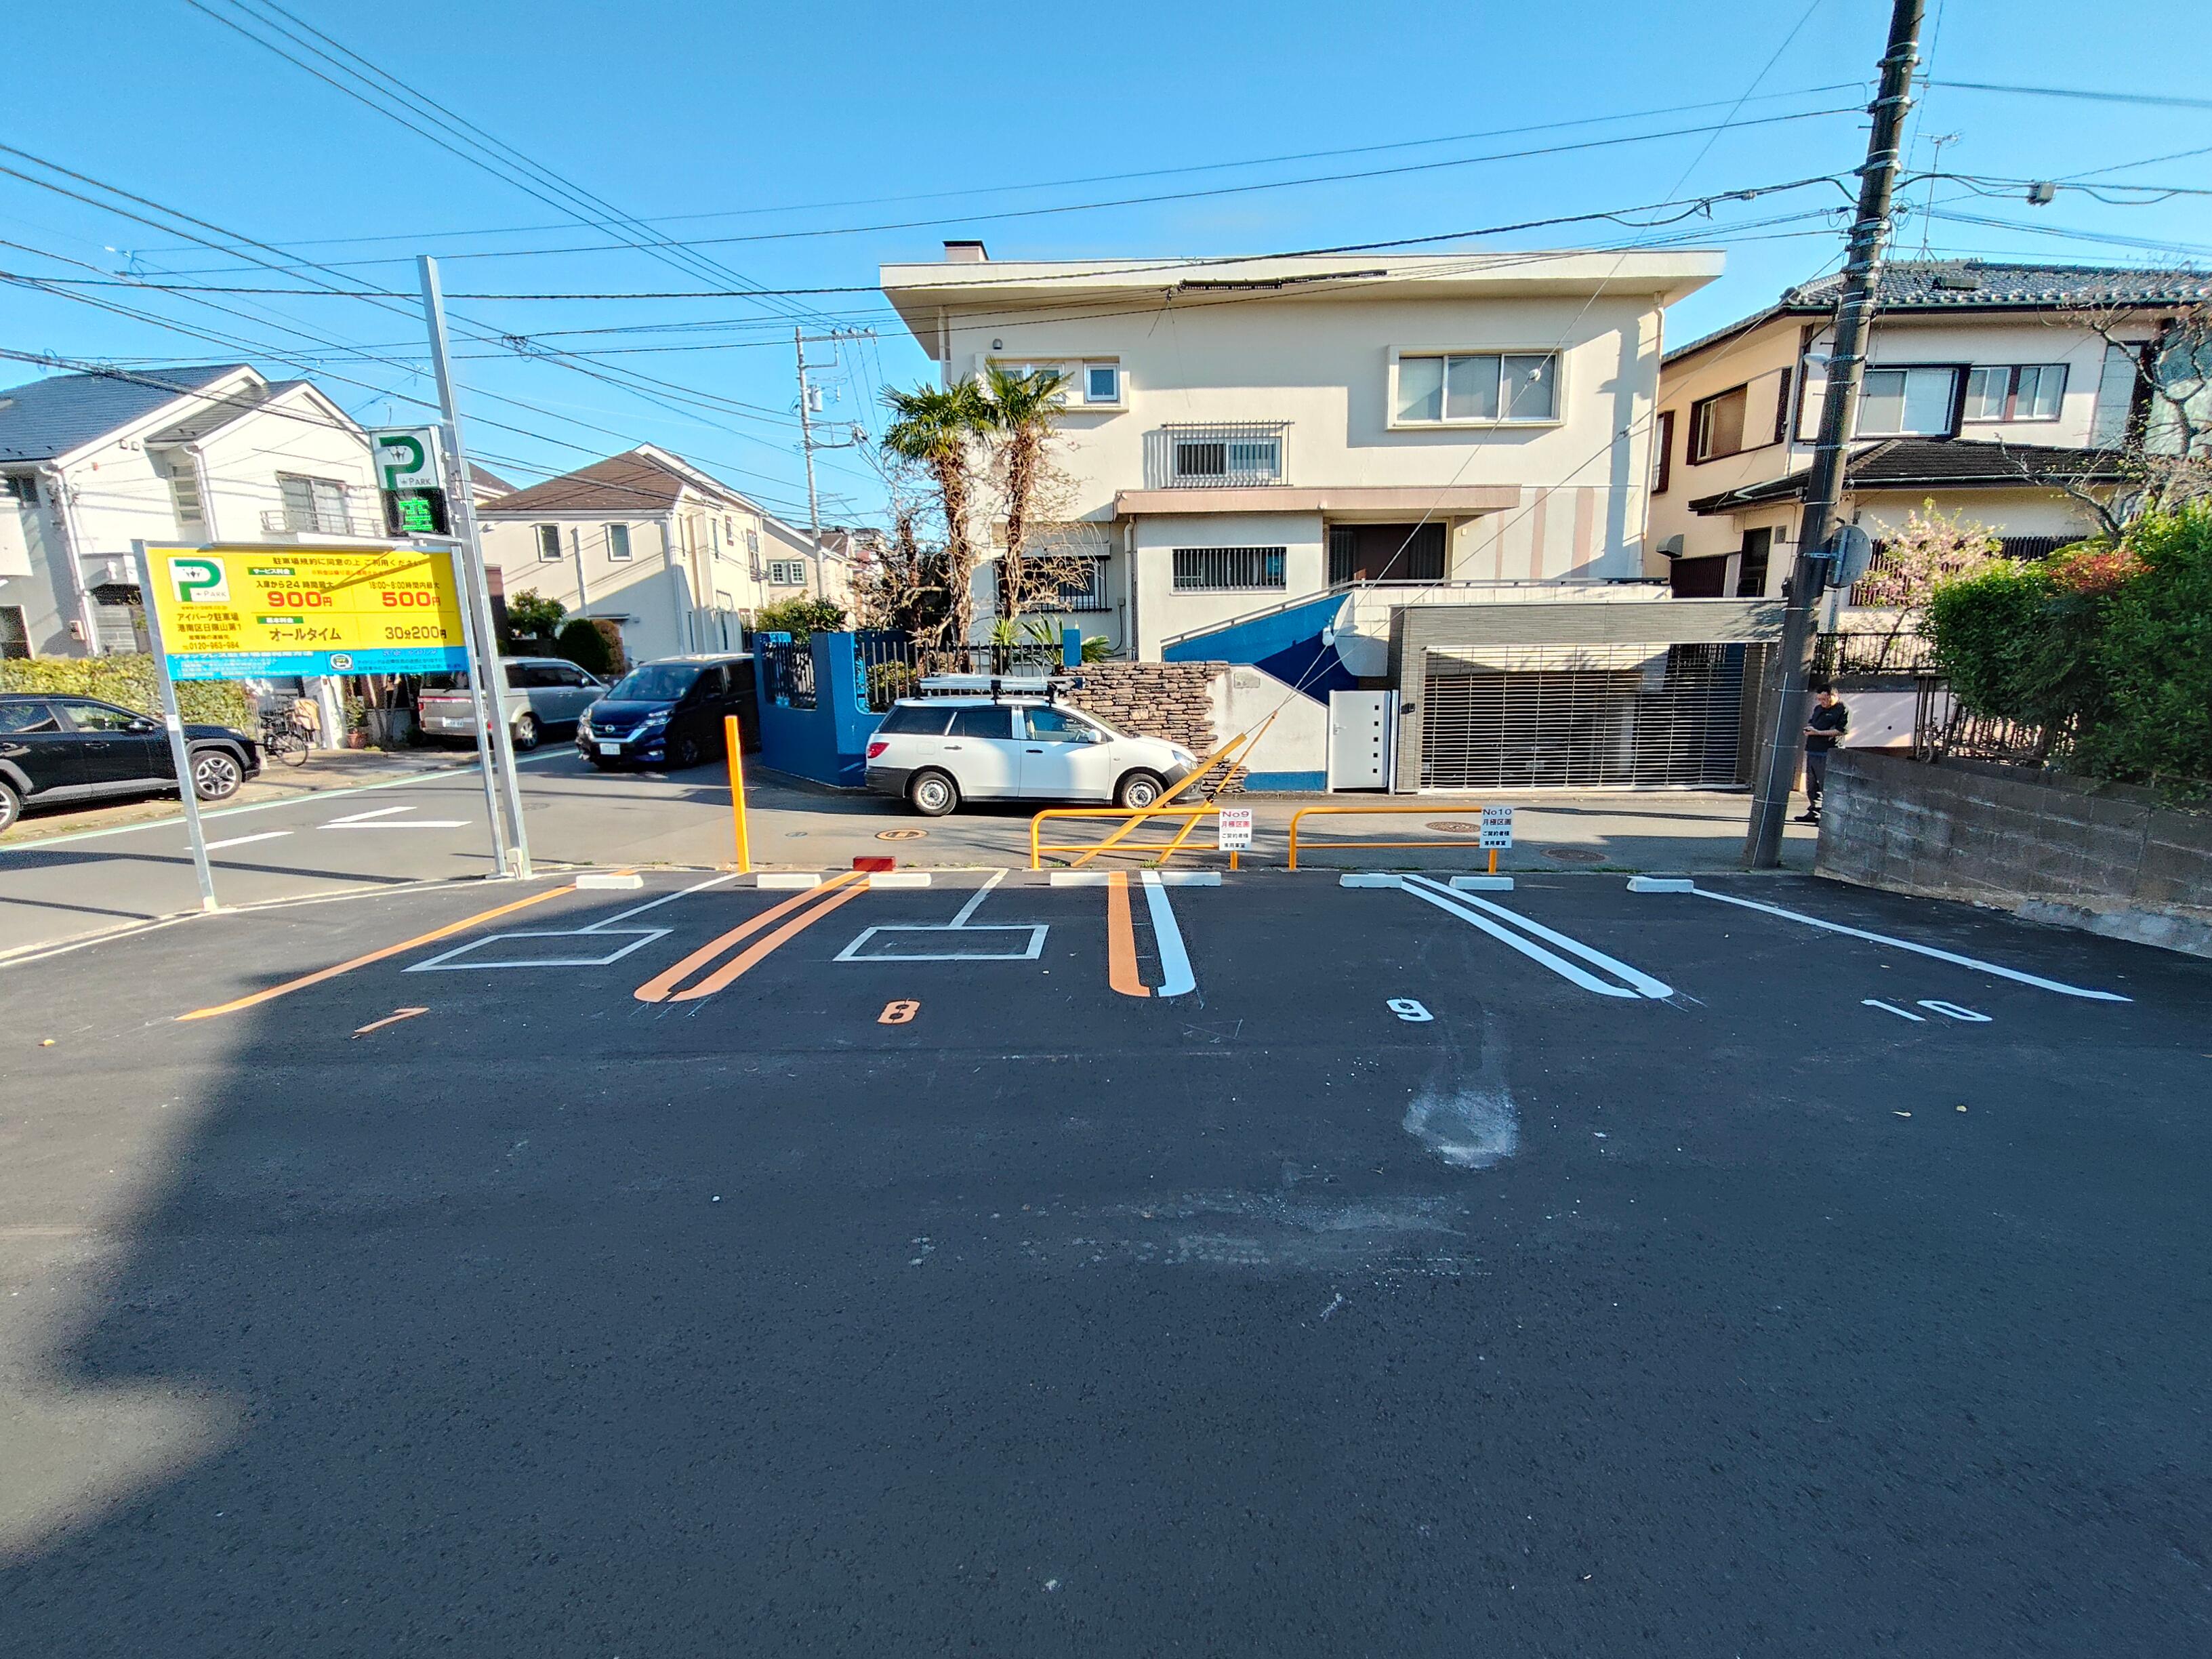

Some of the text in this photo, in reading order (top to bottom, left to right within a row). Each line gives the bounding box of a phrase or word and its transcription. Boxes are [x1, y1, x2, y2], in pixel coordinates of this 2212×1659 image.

[409, 477, 432, 486] PARK
[398, 497, 433, 531] 空
[267, 591, 333, 607] 900円
[382, 592, 441, 607] 500円
[269, 628, 342, 641] オールタイム
[385, 626, 447, 640] 30分200円
[877, 999, 921, 1024] 8
[1386, 998, 1435, 1022] 9
[1860, 999, 1993, 1022] 10
